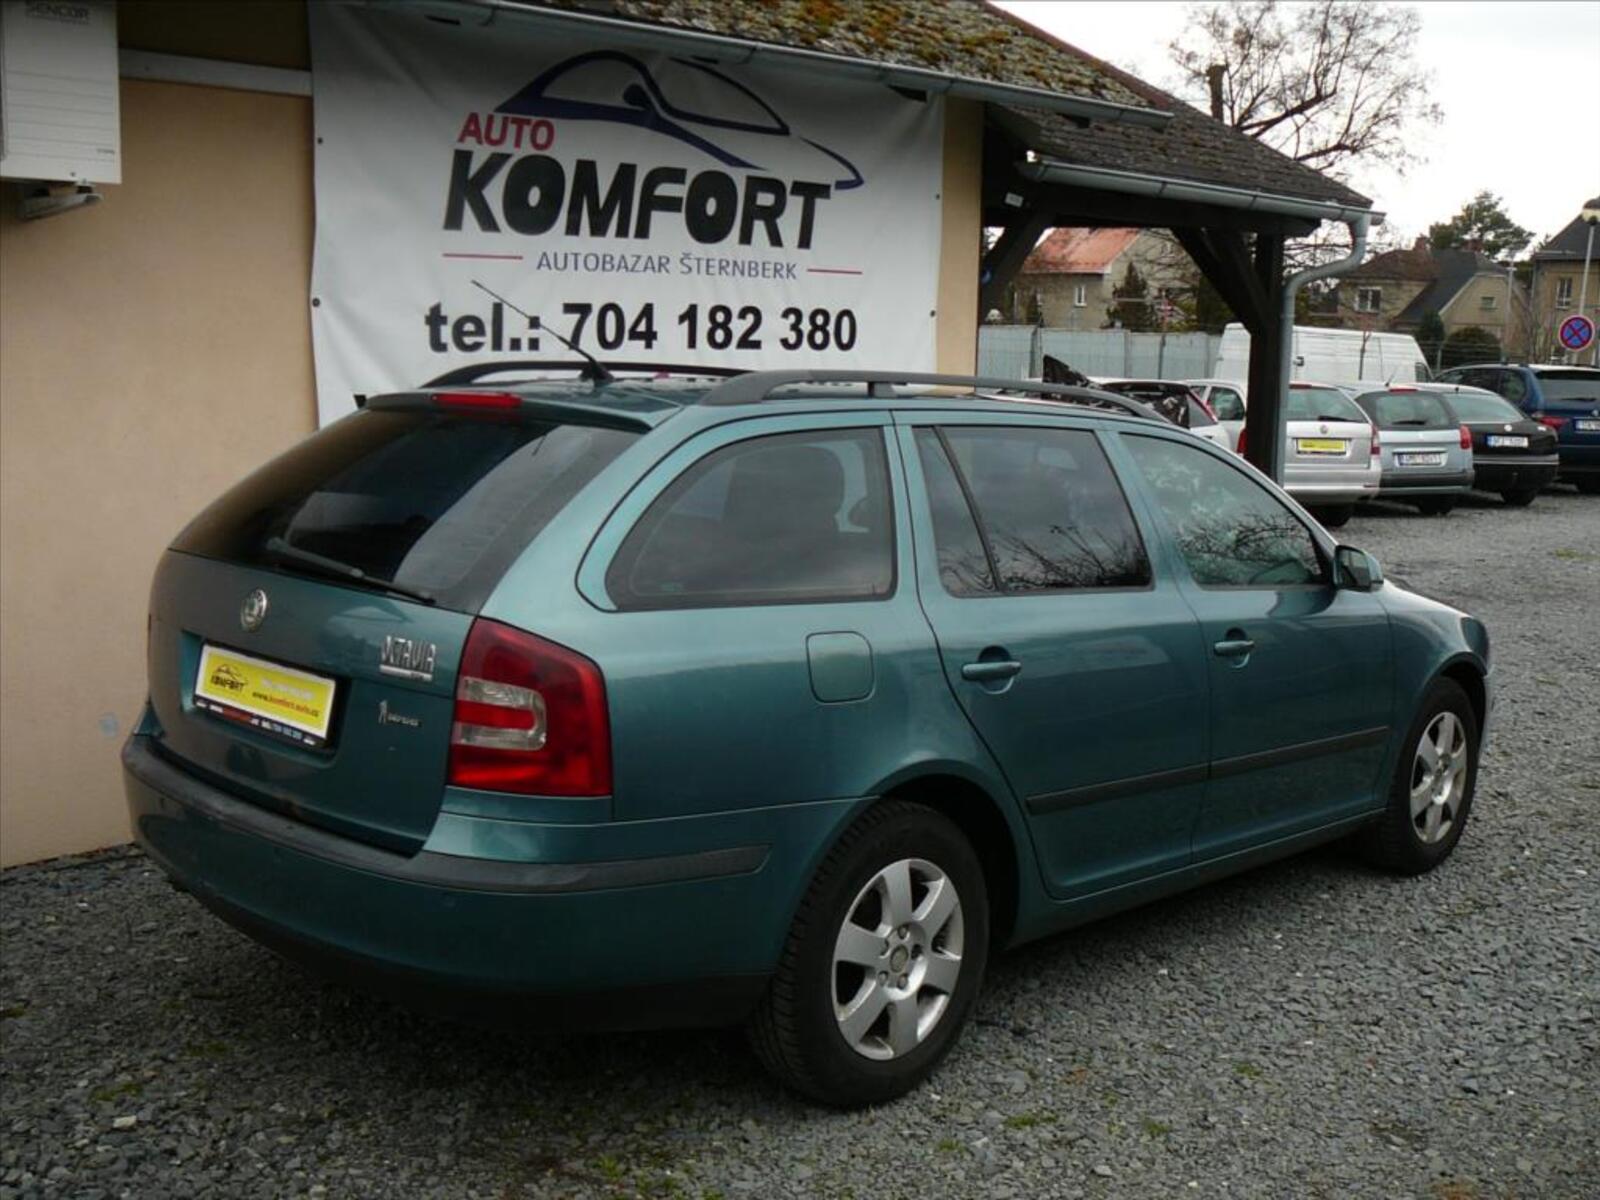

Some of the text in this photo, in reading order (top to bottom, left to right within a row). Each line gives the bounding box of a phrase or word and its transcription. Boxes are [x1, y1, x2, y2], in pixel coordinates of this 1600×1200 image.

[458, 112, 555, 151] AUTO
[443, 149, 831, 250] KOMFORT
[536, 251, 798, 280] AUTOBAZAR ŠTERNBERK
[425, 302, 857, 352] tel.: 704 182 380
